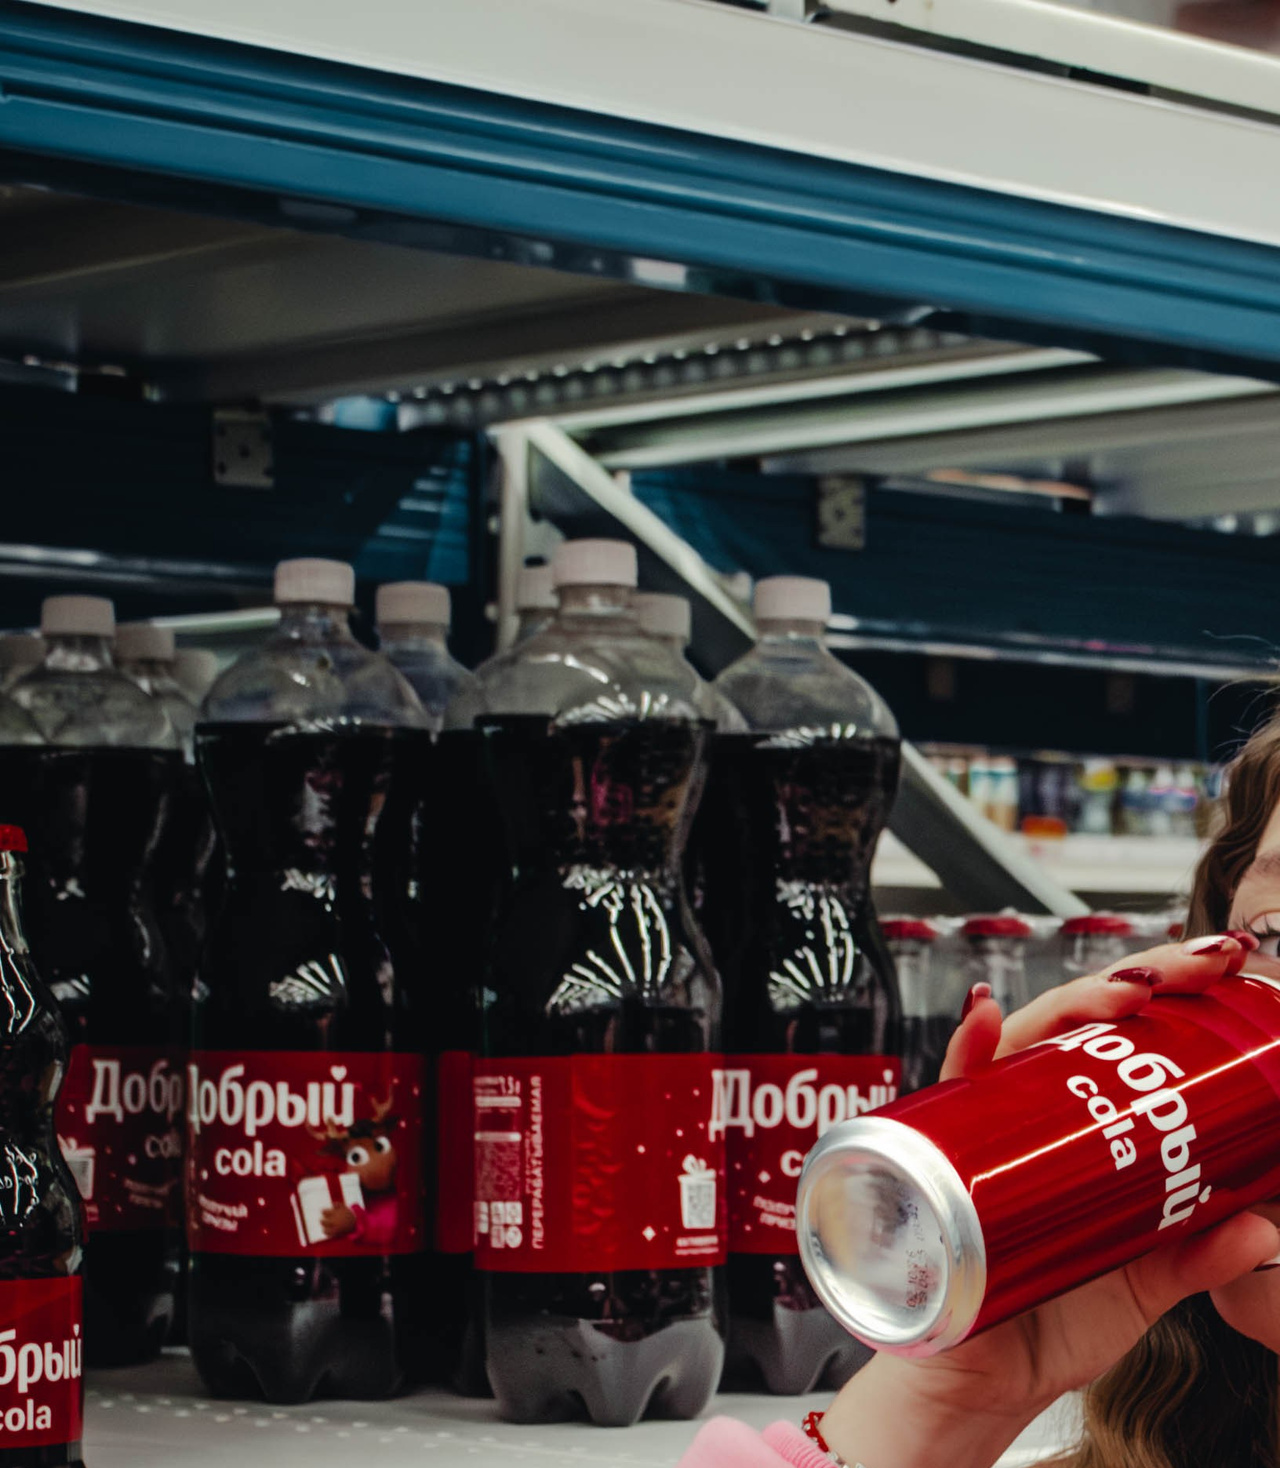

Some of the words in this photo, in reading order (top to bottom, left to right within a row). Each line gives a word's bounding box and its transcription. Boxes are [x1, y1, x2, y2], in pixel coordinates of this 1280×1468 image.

[1030, 1022, 1212, 1232] Добрый
[1066, 1075, 1137, 1171] cola
[215, 1140, 287, 1178] cola
[0, 1398, 52, 1432] ola
